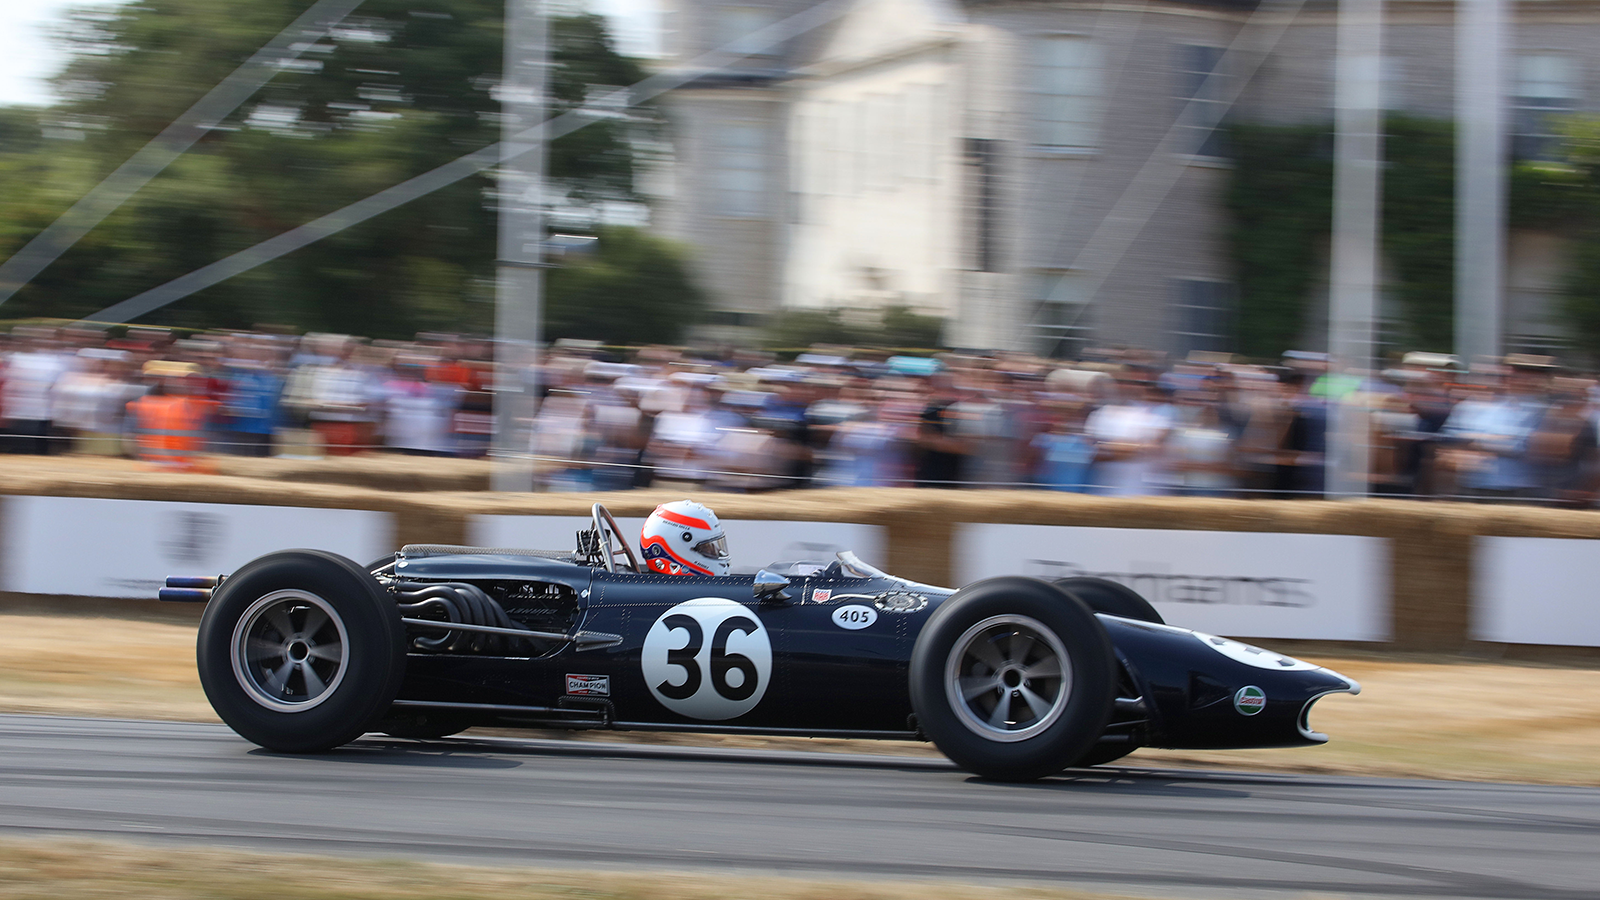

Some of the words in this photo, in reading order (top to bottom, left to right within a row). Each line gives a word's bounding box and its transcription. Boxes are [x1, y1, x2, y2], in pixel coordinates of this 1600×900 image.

[840, 610, 869, 623] 405
[656, 613, 759, 701] 36
[569, 681, 606, 690] CHAMPION
